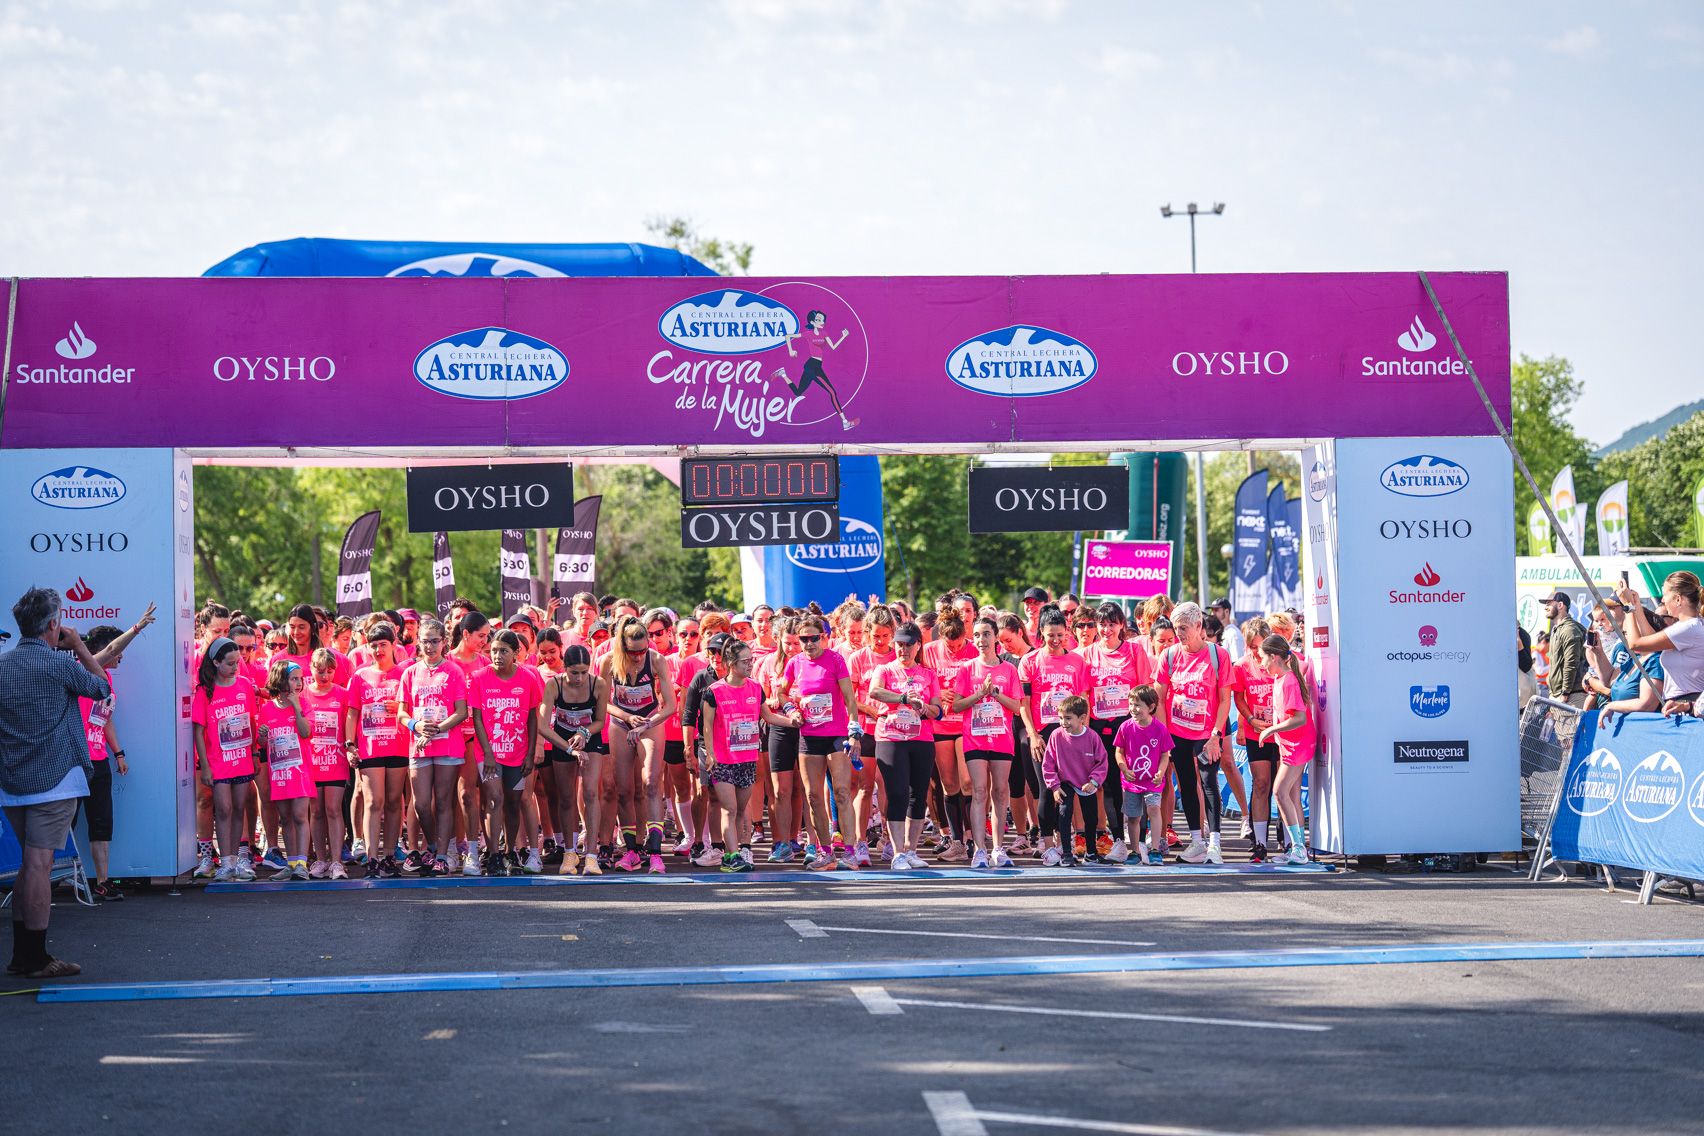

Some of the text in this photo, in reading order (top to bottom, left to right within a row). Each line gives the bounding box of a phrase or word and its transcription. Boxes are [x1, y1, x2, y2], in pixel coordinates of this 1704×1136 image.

[690, 311, 785, 319] CENTRAL LECHERA
[669, 313, 789, 338] ASTURIANA
[449, 351, 500, 361] CENTRAL
[980, 349, 1081, 358] CENTRAL LECHERA
[212, 355, 336, 383] OYSHO
[425, 353, 558, 383] ASTURIANA
[646, 350, 763, 385] Carrera
[956, 352, 1087, 380] ASTURIANA
[1171, 350, 1290, 377] OYSHO
[16, 363, 136, 385] Santander
[675, 380, 806, 438] de la Mujer
[1386, 470, 1463, 487] ASTURIANA
[38, 482, 120, 499] ASTURIANA
[433, 483, 551, 512] OYSHO
[994, 487, 1108, 512] OYSHO
[562, 529, 594, 540] OYSHO
[688, 509, 833, 543] OYSHO
[1379, 518, 1473, 540] OYSHO
[29, 532, 129, 553] OYSHO
[793, 543, 879, 560] ASTURIANA
[1134, 549, 1169, 559] OYSHO
[1086, 565, 1168, 581] CORREDORAS
[1389, 589, 1466, 604] Santander
[60, 605, 121, 619] ntander
[1386, 651, 1471, 663] octopus energy
[1249, 683, 1274, 695] CARRE
[486, 697, 520, 709] CARRERA
[1412, 692, 1448, 710] Marlene
[312, 754, 338, 766] MUJER
[1397, 745, 1464, 761] Neutrogena
[1625, 776, 1677, 806] ASTURIANA
